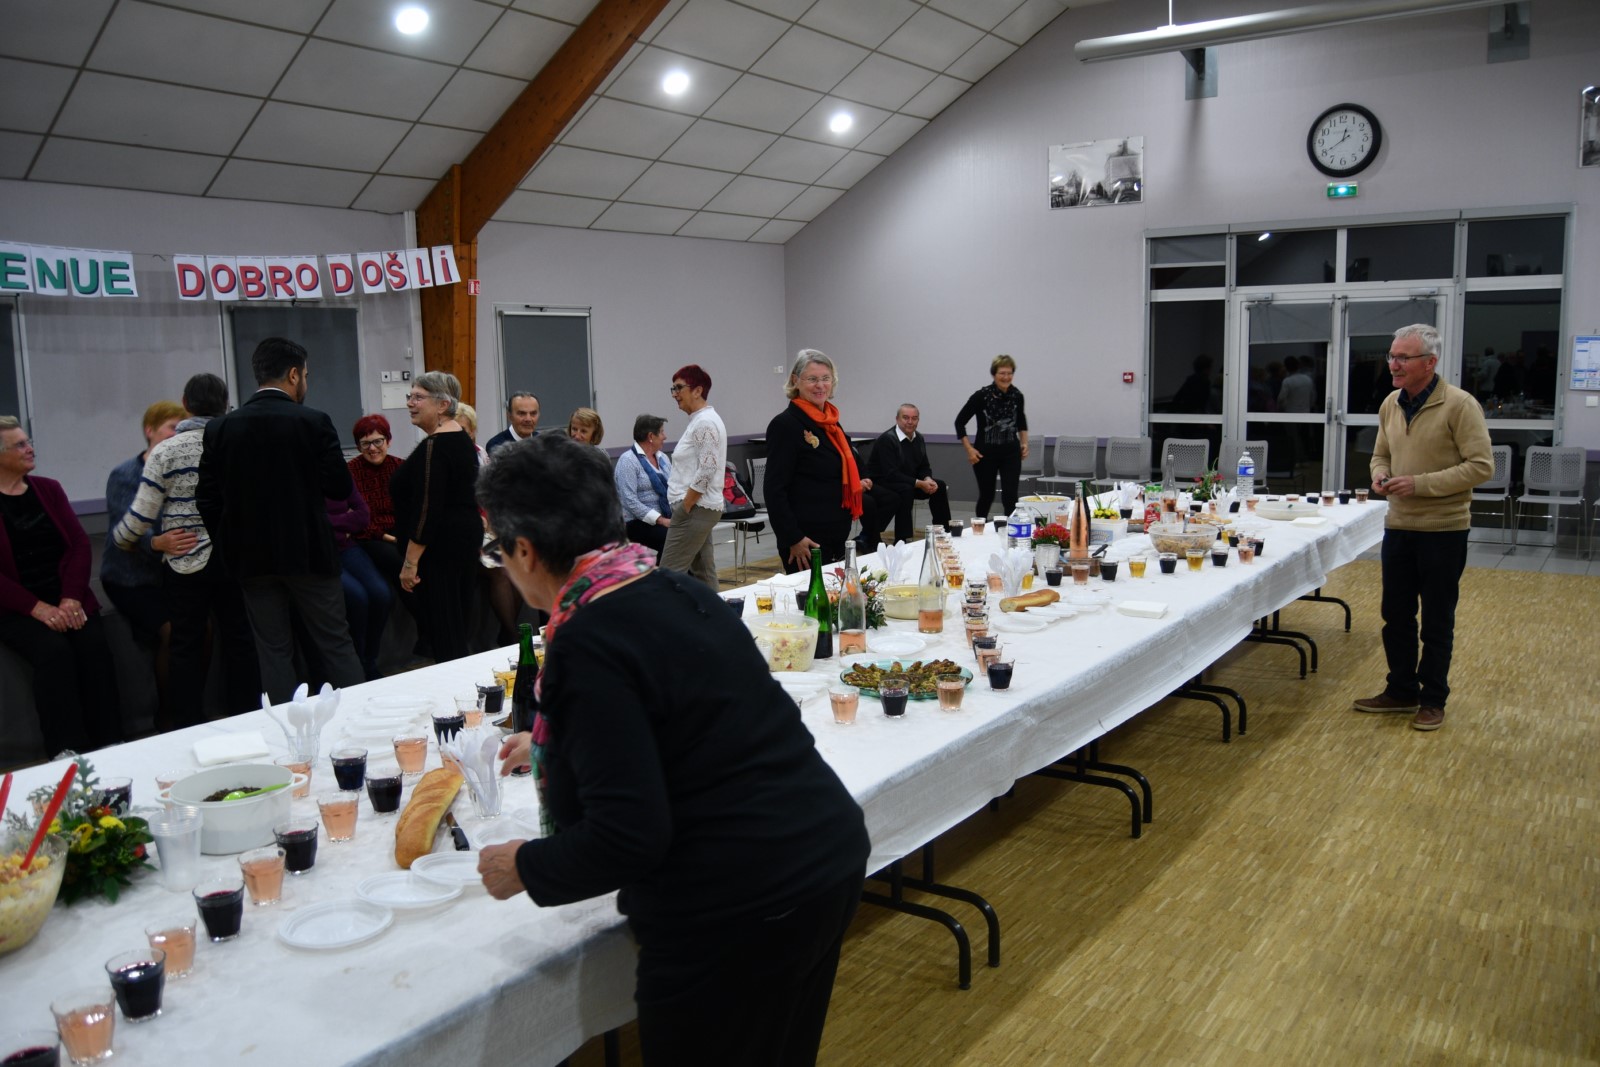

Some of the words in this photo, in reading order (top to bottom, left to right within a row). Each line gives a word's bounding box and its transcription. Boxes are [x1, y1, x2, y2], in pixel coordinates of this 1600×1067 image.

[1340, 114, 1348, 124] 12
[1352, 116, 1355, 124] 1
[1329, 119, 1336, 128] 11
[1358, 123, 1365, 132] 2
[1322, 128, 1330, 136] 10
[1318, 139, 1325, 147] 9
[1322, 148, 1328, 156] 8
[1330, 155, 1335, 164] 7
[1340, 158, 1346, 166] 6
[177, 263, 319, 298] DOBRO
